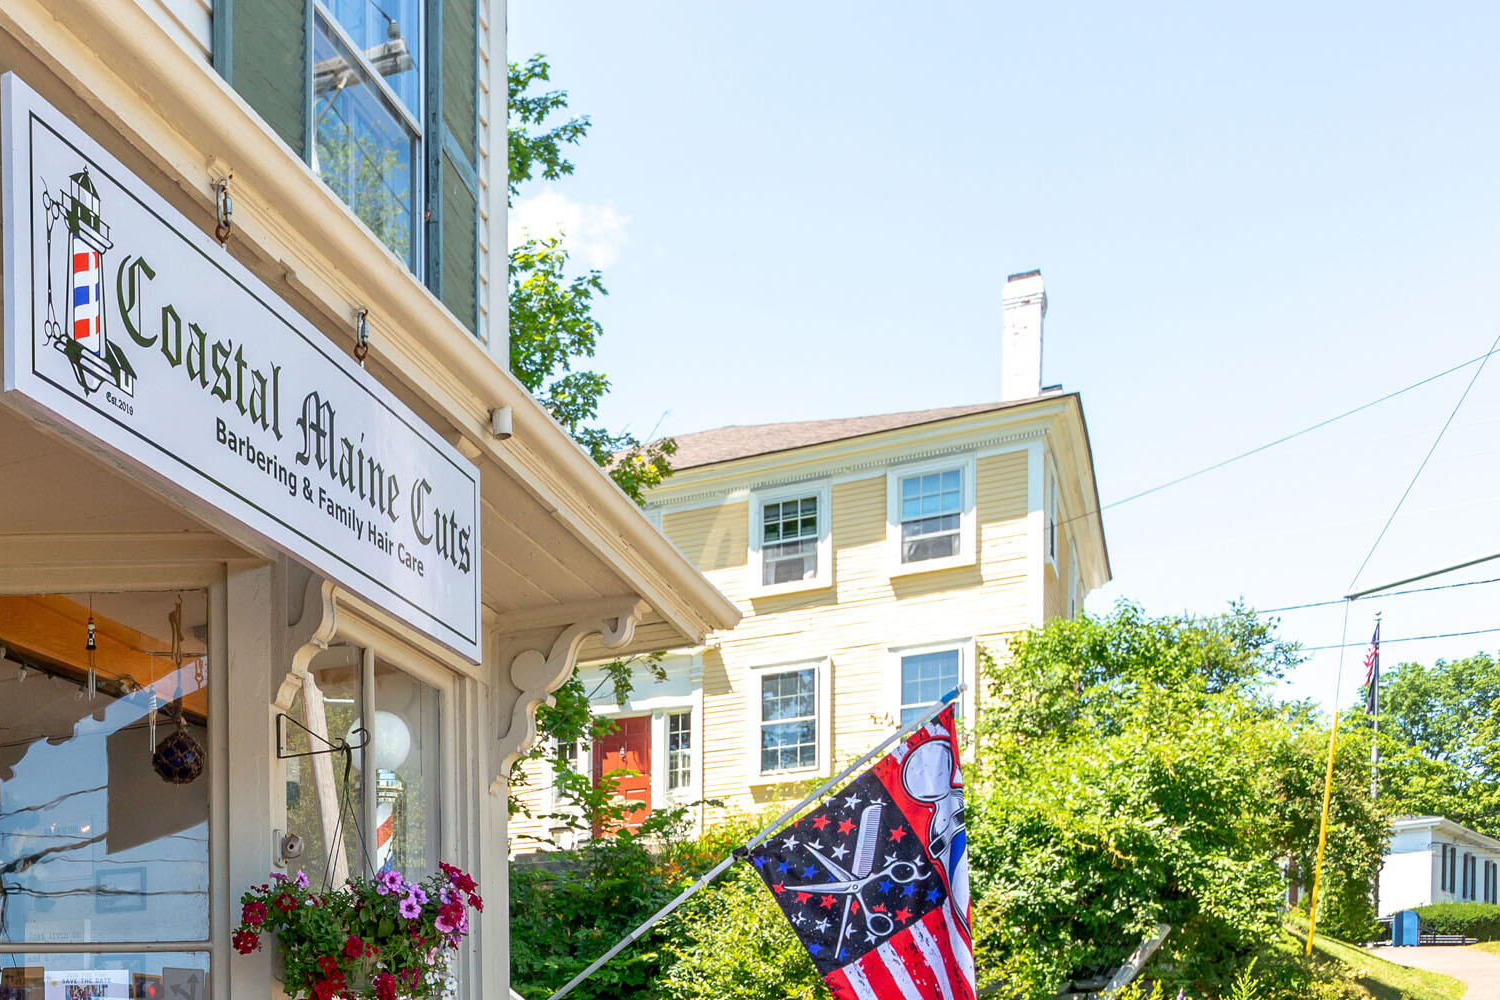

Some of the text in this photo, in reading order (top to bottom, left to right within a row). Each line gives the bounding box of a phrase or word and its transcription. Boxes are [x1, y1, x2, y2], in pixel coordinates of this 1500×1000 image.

[117, 255, 471, 574] Coastal Maine Cuts
[217, 417, 424, 577] Barbering & Family Hair Care
